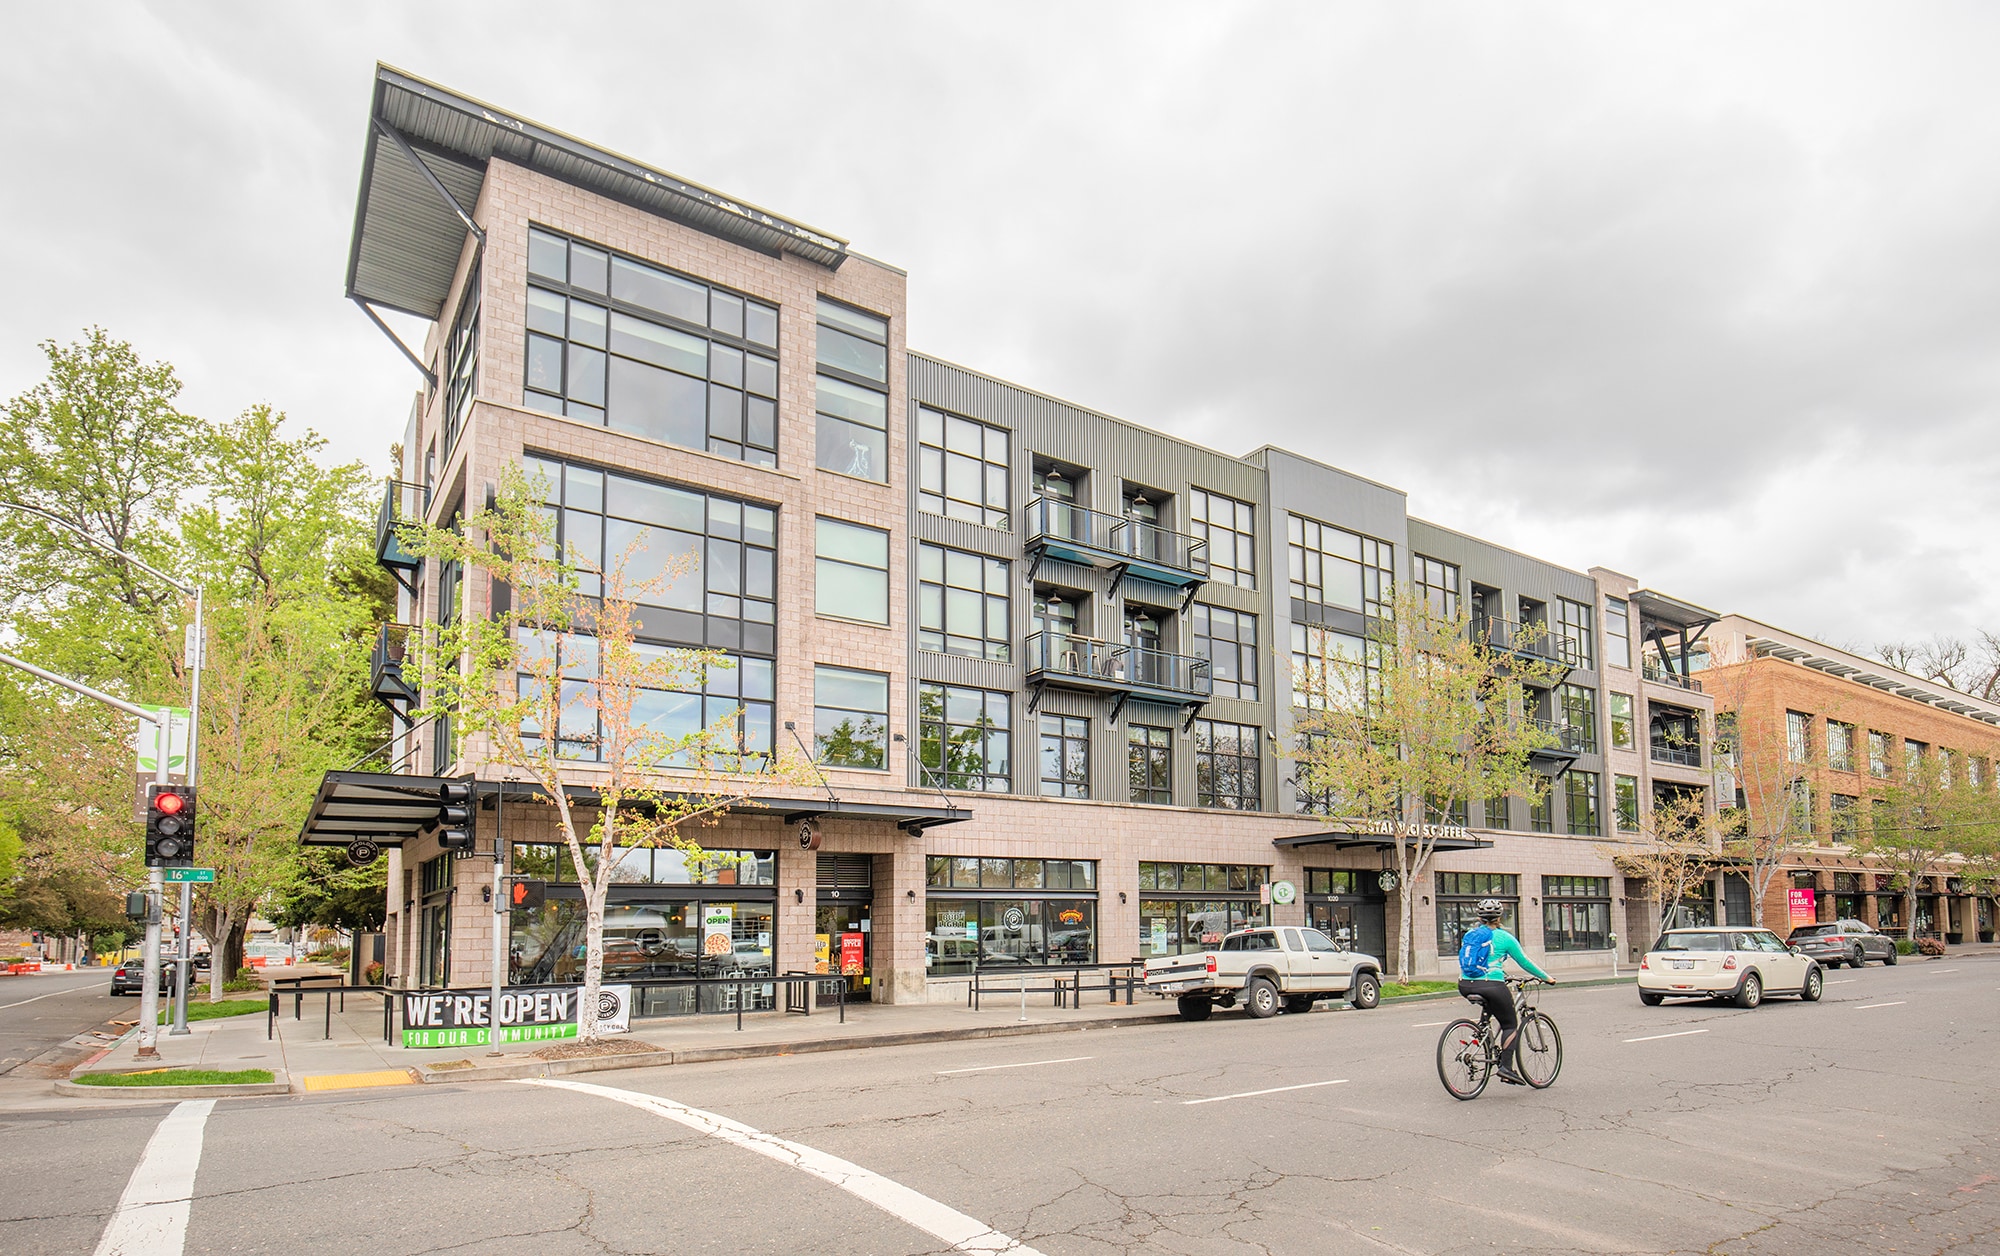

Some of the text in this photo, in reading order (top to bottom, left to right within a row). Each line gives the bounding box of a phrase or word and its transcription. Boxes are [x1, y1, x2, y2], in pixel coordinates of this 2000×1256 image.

[1368, 820, 1430, 836] STARCS
[831, 890, 840, 898] 10
[1148, 969, 1164, 977] TOYOTA
[407, 993, 568, 1026] WE'RE OPEN
[408, 1031, 429, 1045] FOR
[438, 1030, 467, 1045] OUR
